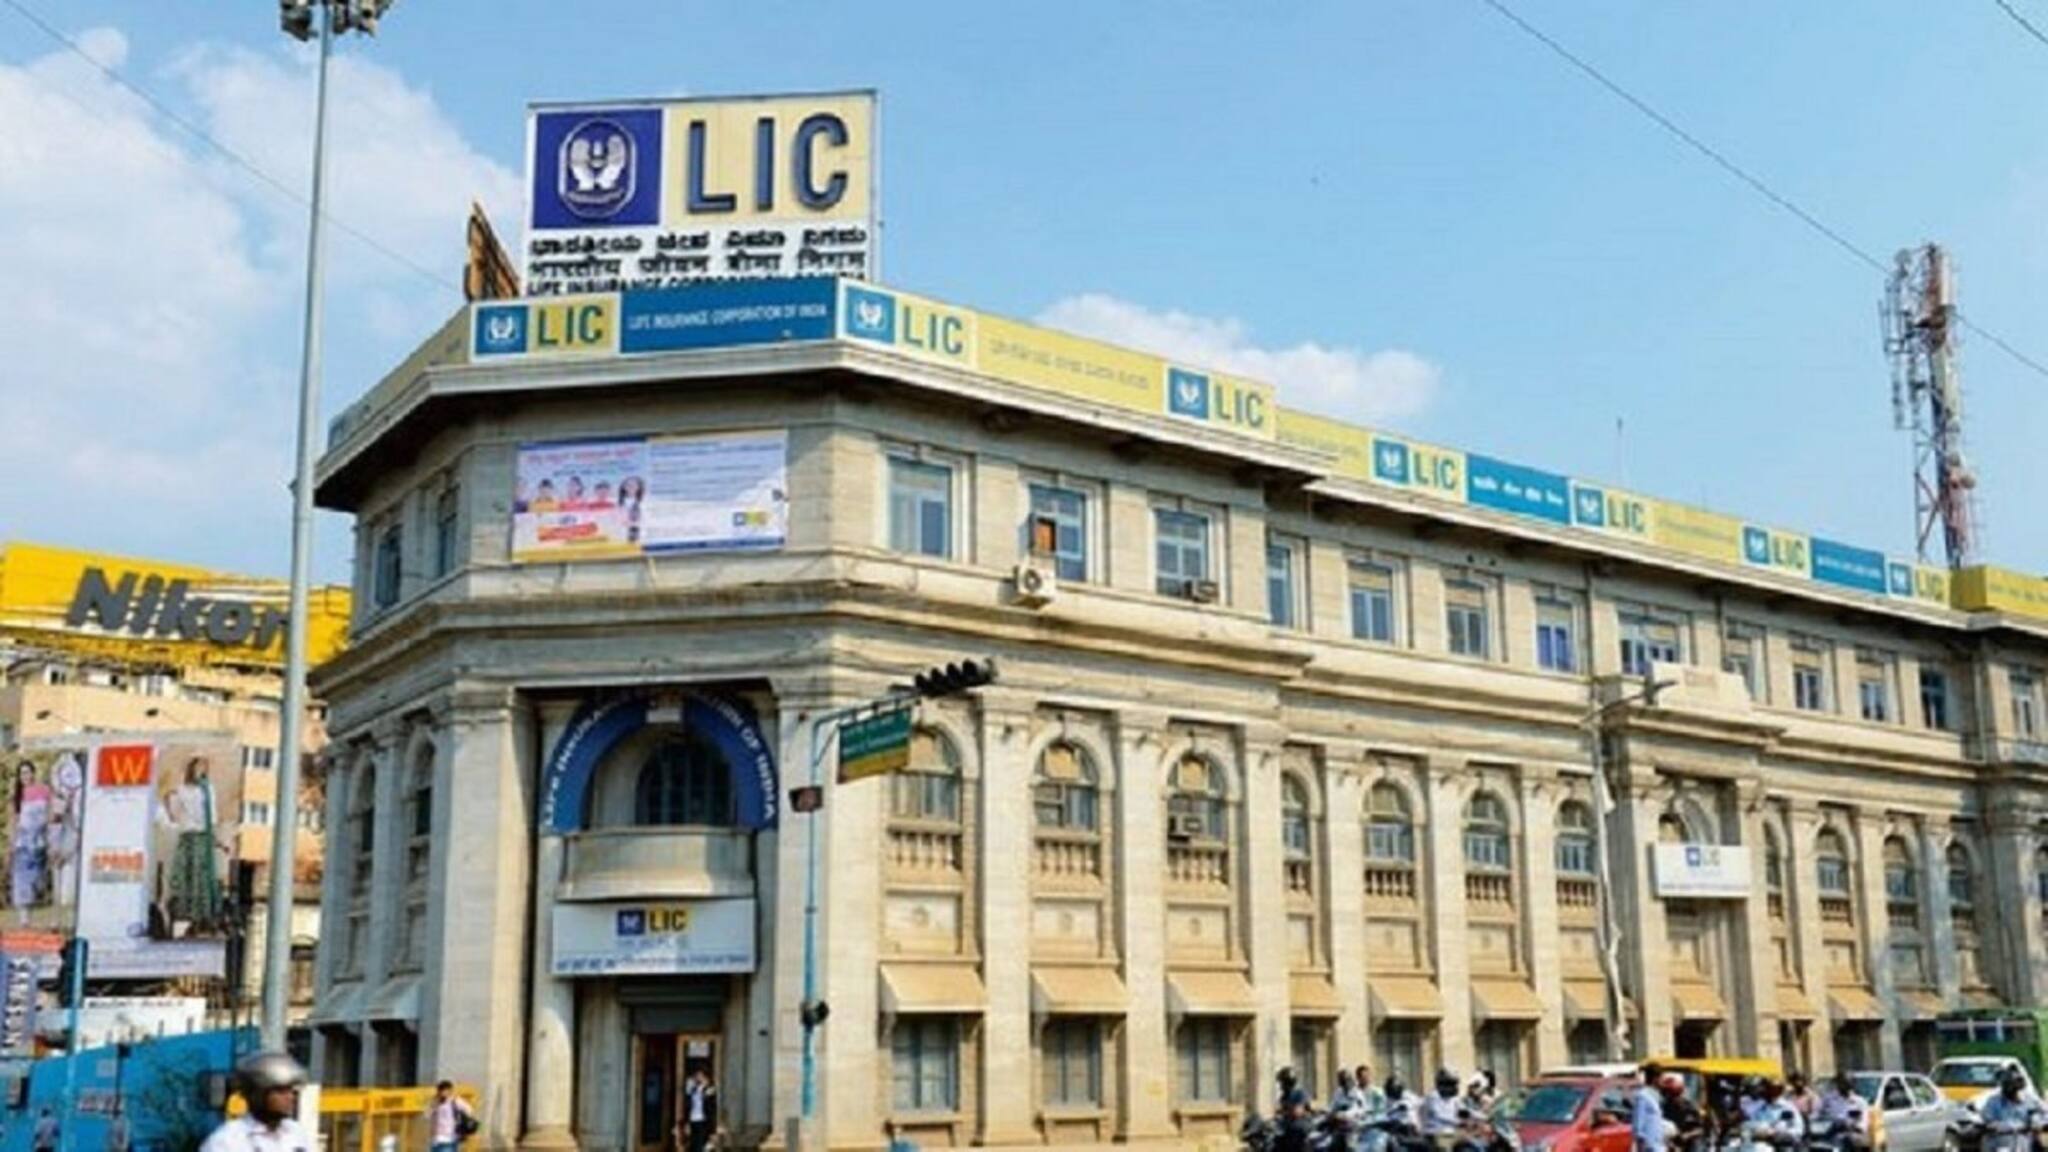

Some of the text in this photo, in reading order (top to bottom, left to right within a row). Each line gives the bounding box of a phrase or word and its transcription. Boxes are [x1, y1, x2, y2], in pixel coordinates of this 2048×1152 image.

[686, 112, 848, 214] LIC
[537, 304, 603, 345] LIC
[903, 306, 963, 355] LIC
[1215, 384, 1264, 427] LIC
[1413, 453, 1456, 490] LIC
[1607, 497, 1645, 532] LIC
[111, 755, 146, 783] W
[649, 909, 688, 932] LIC
